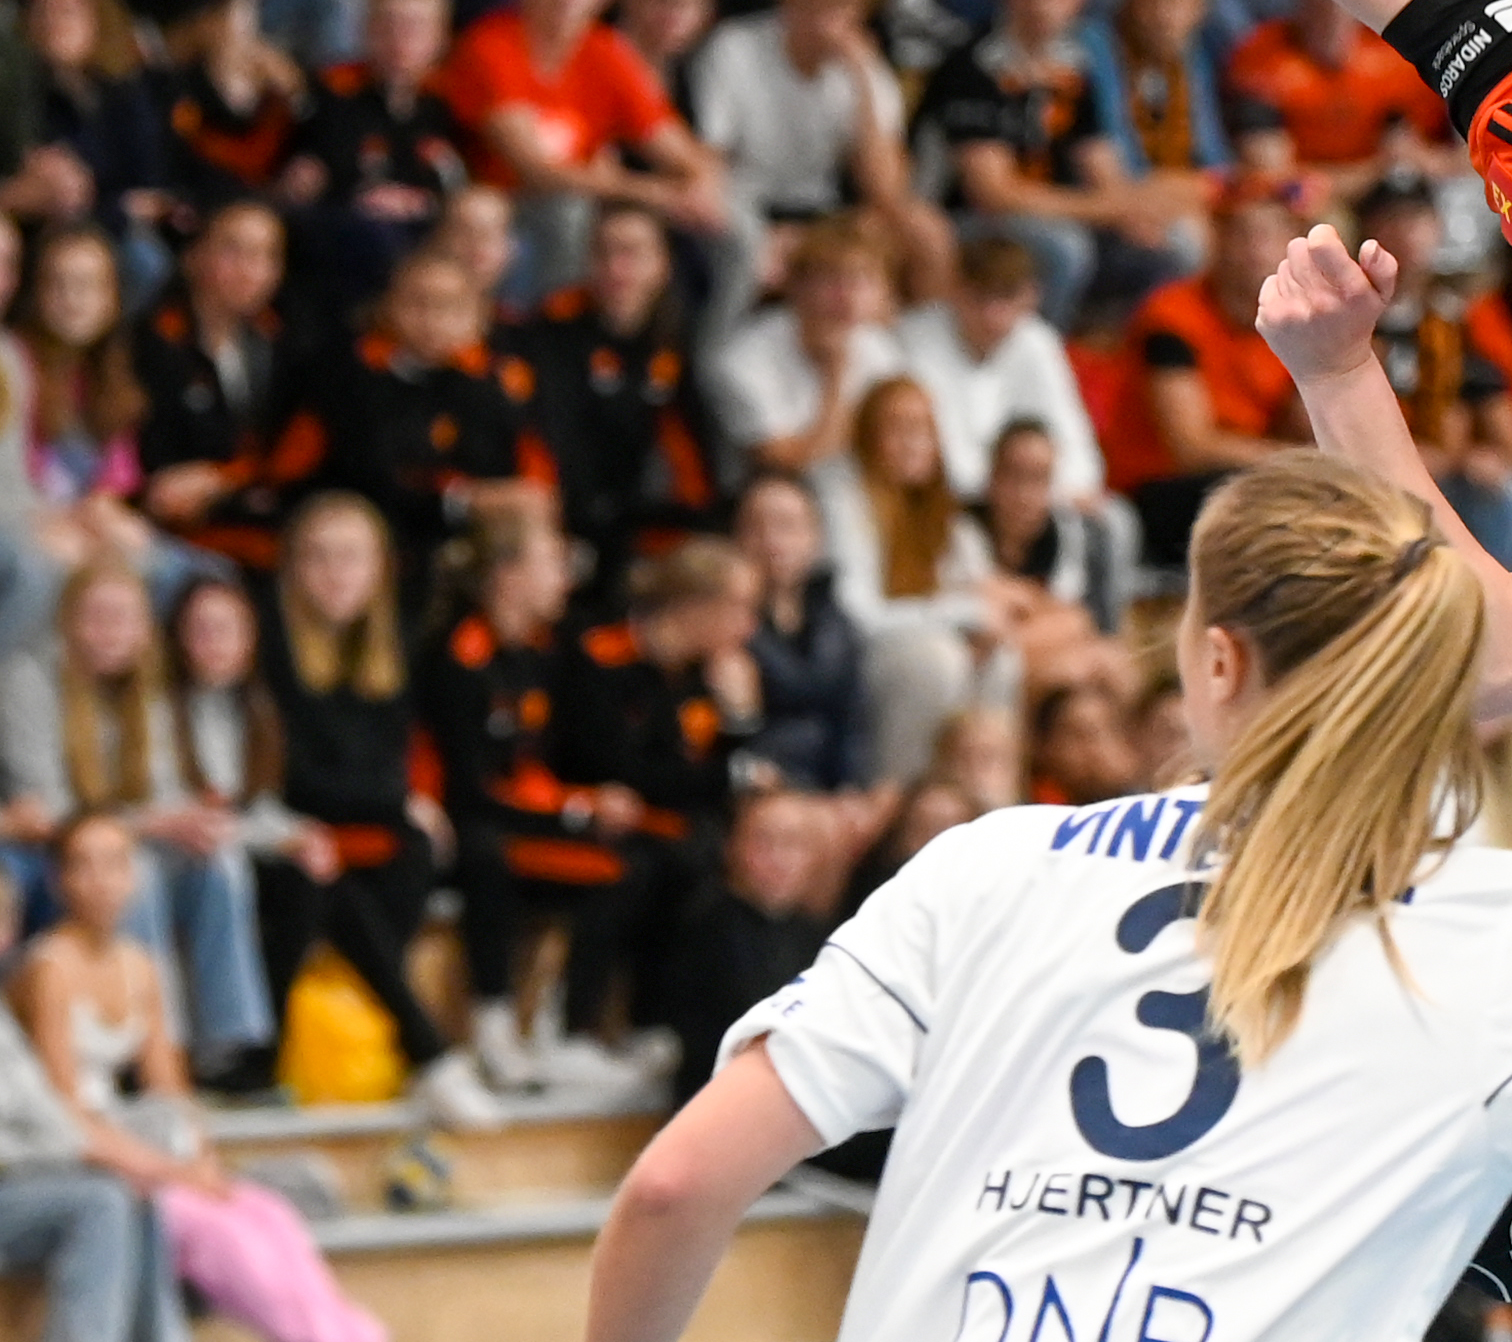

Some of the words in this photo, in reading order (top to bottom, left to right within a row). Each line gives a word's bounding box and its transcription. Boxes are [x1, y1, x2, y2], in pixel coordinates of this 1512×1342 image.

[1440, 28, 1492, 98] NIDAROS
[1069, 883, 1243, 1162] 3
[976, 1169, 1273, 1243] HJERTNER
